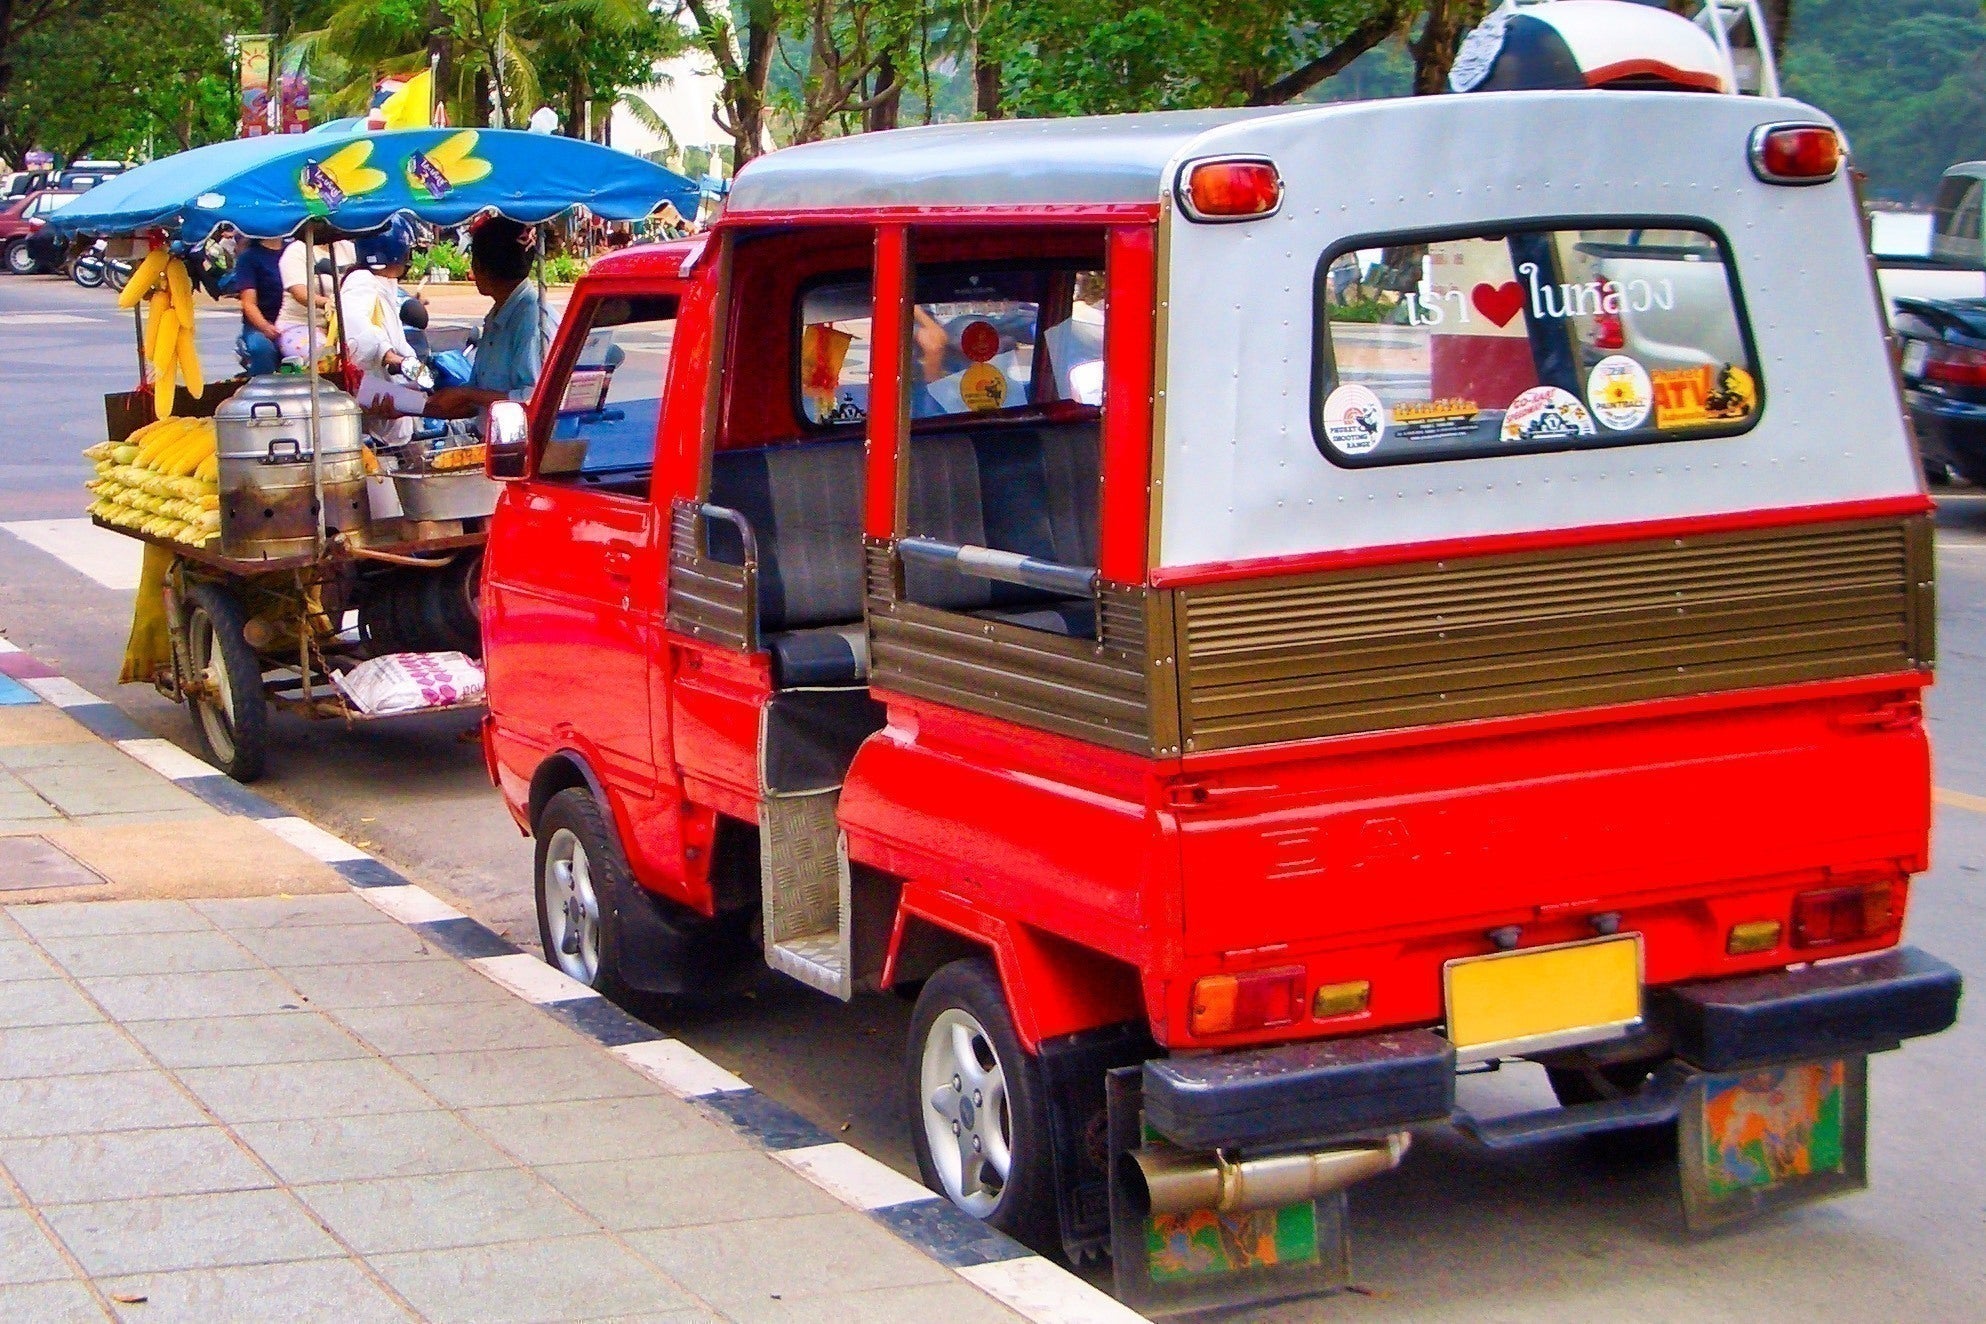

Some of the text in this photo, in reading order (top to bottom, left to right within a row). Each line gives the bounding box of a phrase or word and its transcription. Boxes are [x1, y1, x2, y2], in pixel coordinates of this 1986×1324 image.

[1405, 262, 1676, 326] เรา ในหลวง
